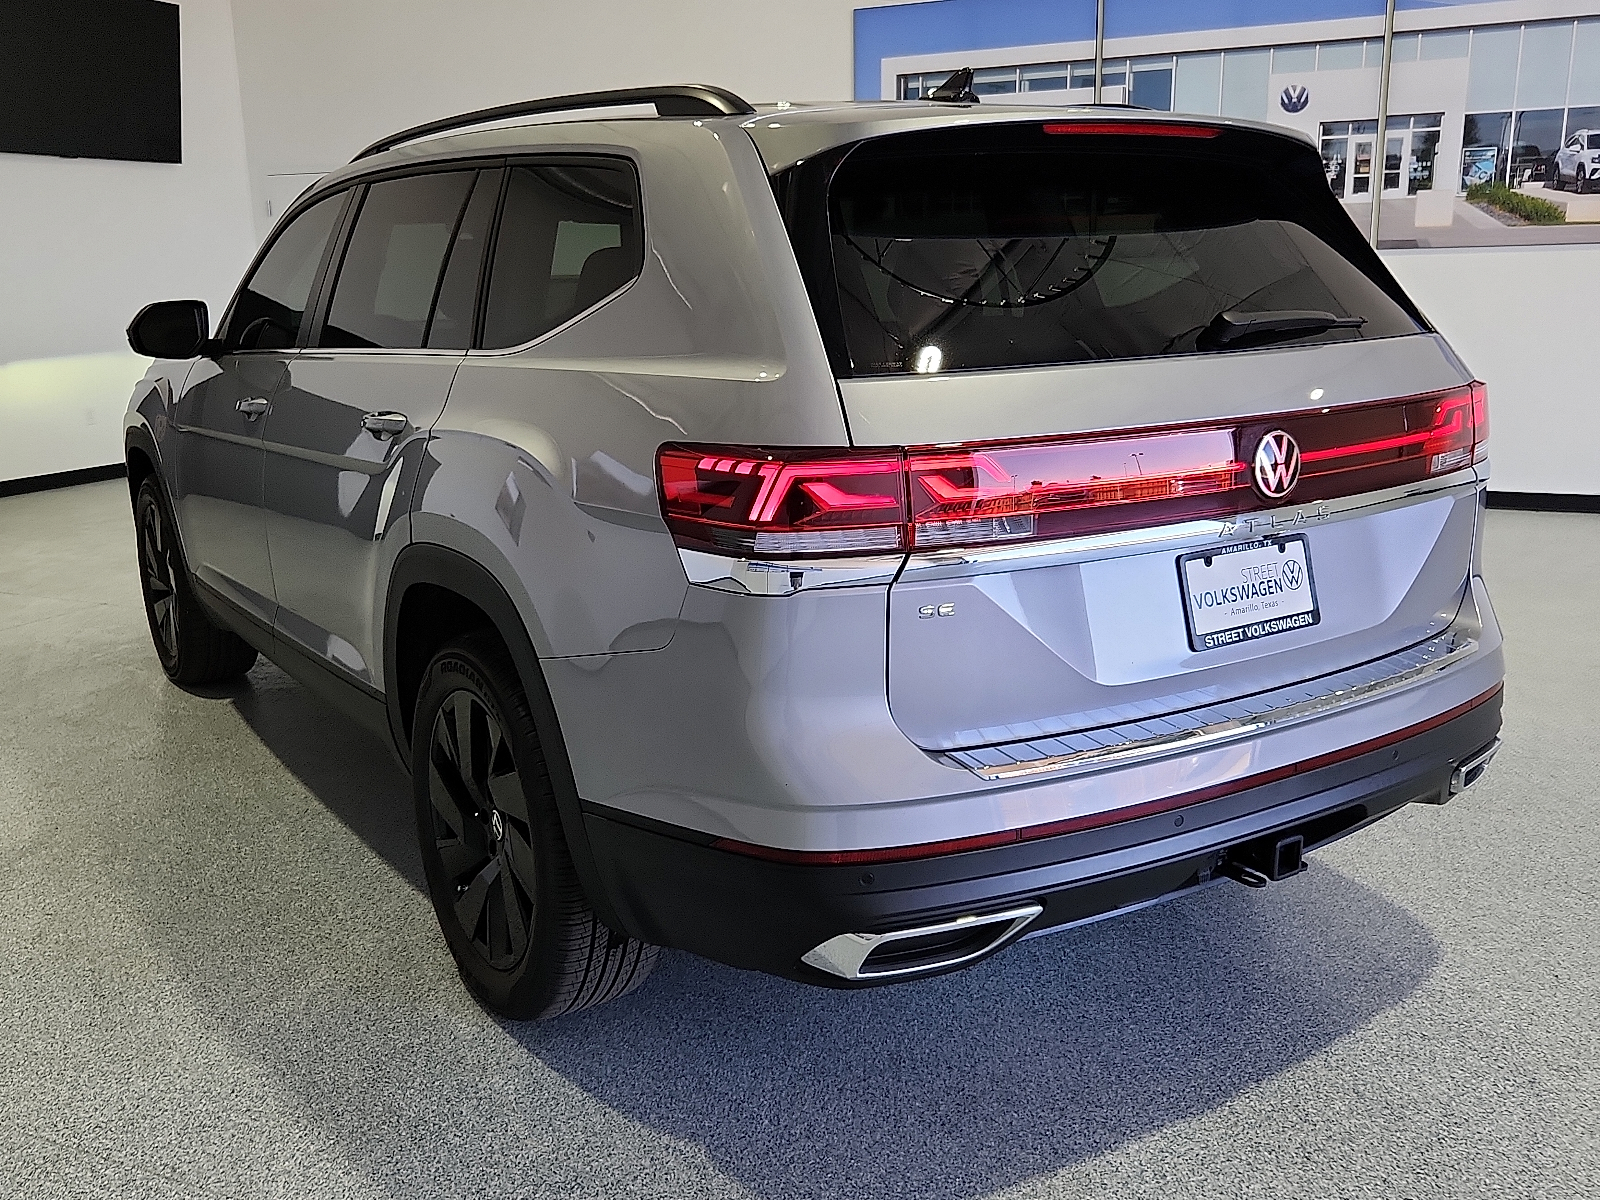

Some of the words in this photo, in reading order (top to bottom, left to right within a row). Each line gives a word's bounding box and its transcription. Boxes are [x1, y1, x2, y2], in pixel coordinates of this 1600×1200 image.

[1255, 430, 1301, 497] VW
[1218, 505, 1330, 538] ATLAS
[1262, 540, 1273, 548] TX
[1240, 562, 1279, 584] STREET
[1193, 578, 1284, 610] VOLKSWAGEN
[1261, 600, 1279, 610] Texas
[918, 602, 955, 619] SE
[1204, 630, 1244, 647] STREET
[1245, 613, 1313, 638] VOLKSWAGEN
